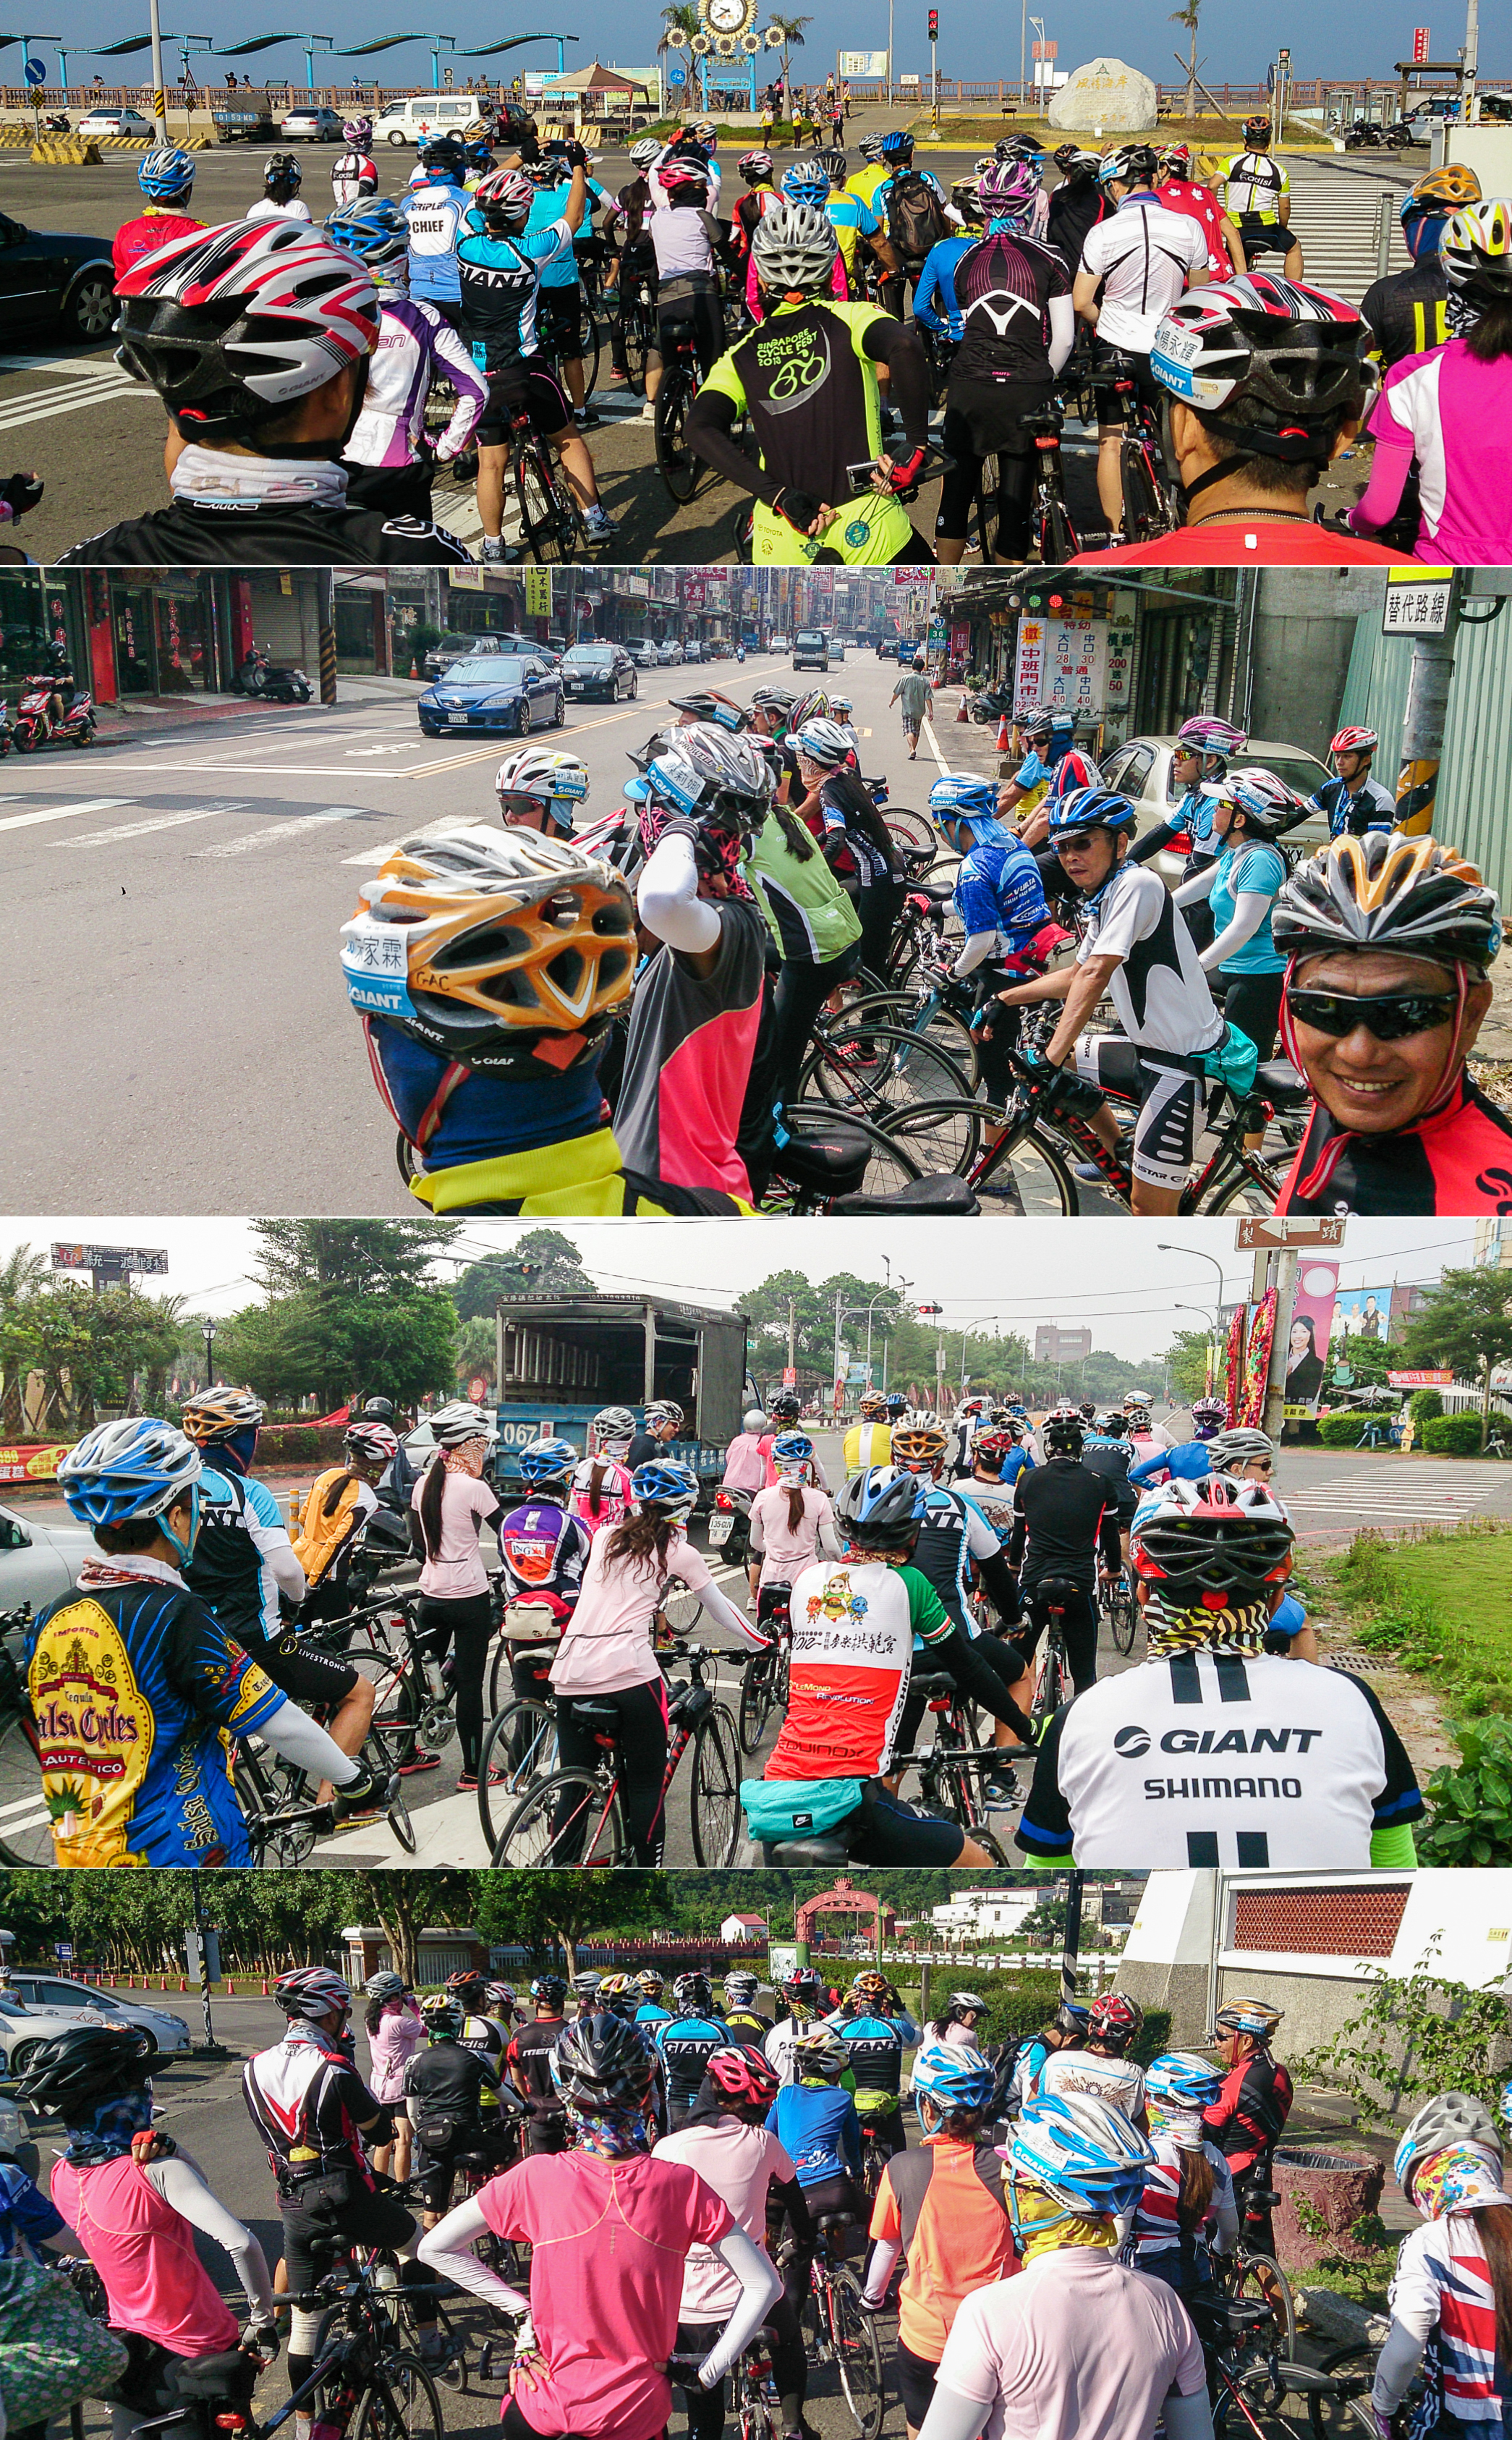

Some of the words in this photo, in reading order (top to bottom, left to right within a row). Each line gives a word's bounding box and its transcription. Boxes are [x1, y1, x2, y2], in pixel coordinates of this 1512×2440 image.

[412, 220, 444, 234] CHIEF
[757, 328, 810, 350] SINGAPORE
[757, 346, 794, 359] CYCLE
[796, 331, 817, 351] FEST
[758, 356, 782, 367] 2013
[1155, 364, 1186, 390] GIANT
[763, 527, 783, 538] TOYOTA
[1388, 593, 1445, 624] 替代路線
[1058, 633, 1069, 652] 大口
[1083, 634, 1095, 653] 中口
[1056, 653, 1069, 664] 28
[1081, 655, 1095, 664] 30
[1108, 658, 1127, 669] 200
[1020, 648, 1040, 696] 中班門市
[1061, 665, 1088, 675] 普通
[1053, 676, 1065, 695] 大口
[1079, 676, 1091, 695] 中口
[1109, 680, 1123, 690] 50
[1077, 695, 1090, 705] 40
[677, 740, 715, 767] PROWELL
[655, 777, 689, 808] GIANT
[416, 971, 450, 992] GAC
[350, 987, 402, 1011] GIANT
[87, 1253, 166, 1271] 統一渡假村
[504, 1423, 538, 1445] 067
[513, 1544, 531, 1555] ING
[298, 1648, 346, 1672] LIVESTRONG
[1160, 1728, 1323, 1754] GIANT
[1144, 1777, 1302, 1800] SHIMANO
[1020, 2153, 1056, 2178] GIANT
[1047, 2185, 1074, 2209] GIANT
